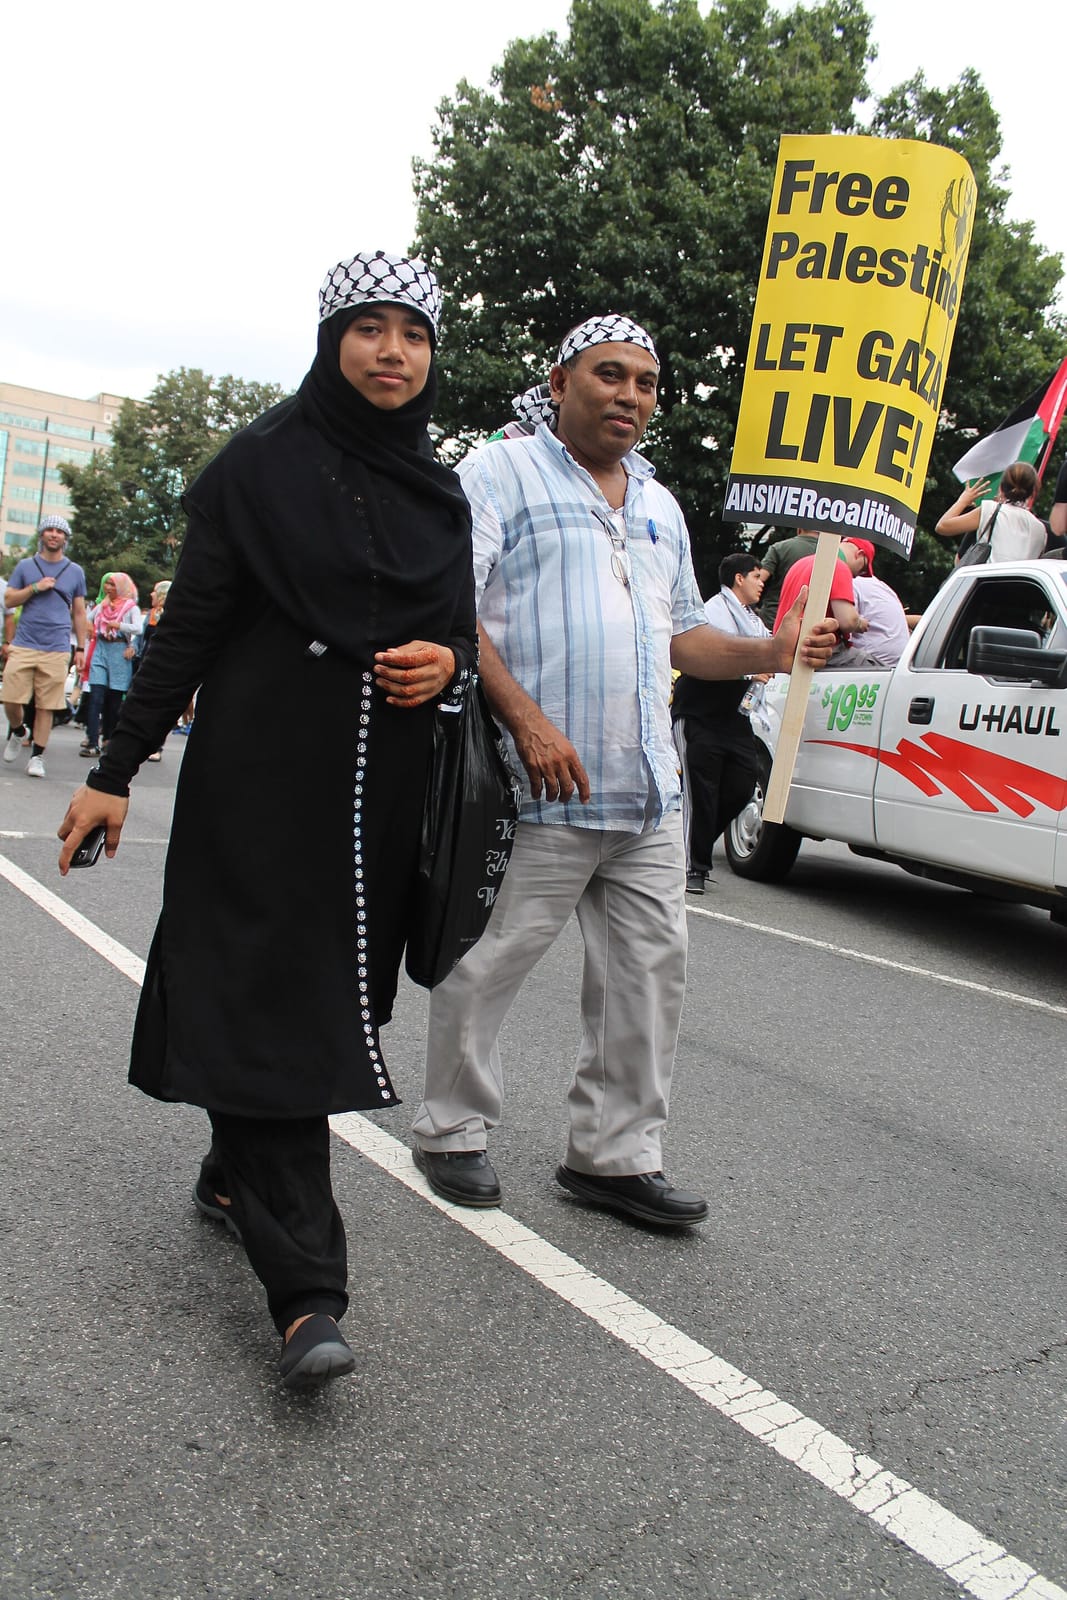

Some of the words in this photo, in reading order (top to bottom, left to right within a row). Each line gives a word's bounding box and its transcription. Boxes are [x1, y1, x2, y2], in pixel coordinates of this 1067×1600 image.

[777, 159, 910, 220] Free
[766, 231, 958, 320] Palestine
[754, 323, 844, 373] LET
[857, 330, 943, 412] GAZA
[765, 391, 924, 489] LIVE!
[725, 482, 915, 555] ANSWERcoalition.org
